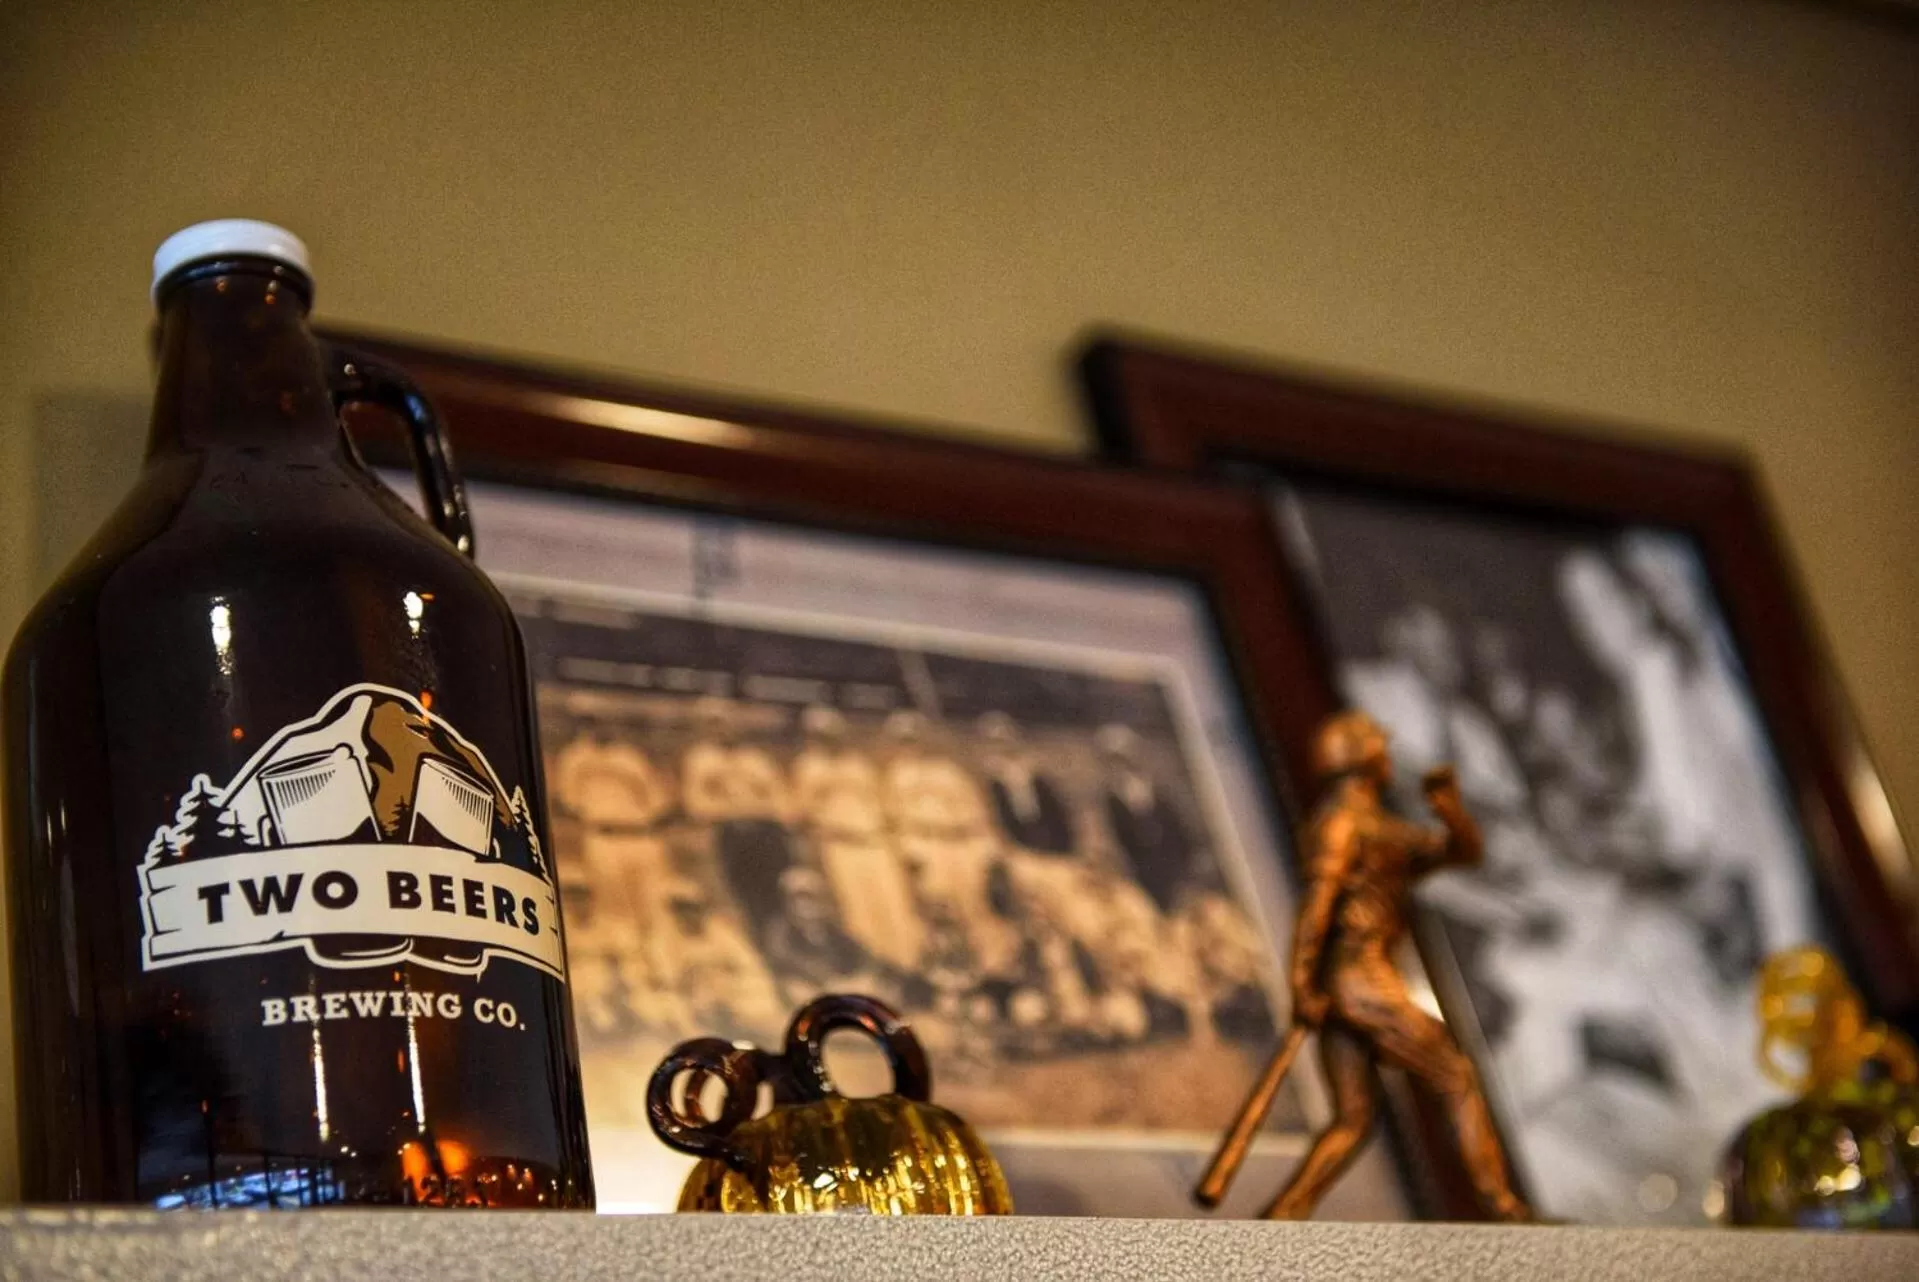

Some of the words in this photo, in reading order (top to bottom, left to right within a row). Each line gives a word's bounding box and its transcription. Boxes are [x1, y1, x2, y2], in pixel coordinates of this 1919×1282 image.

[197, 870, 359, 925] TWO
[386, 870, 540, 936] BEERS
[261, 990, 462, 1027] BREWING
[473, 998, 526, 1031] CO.
